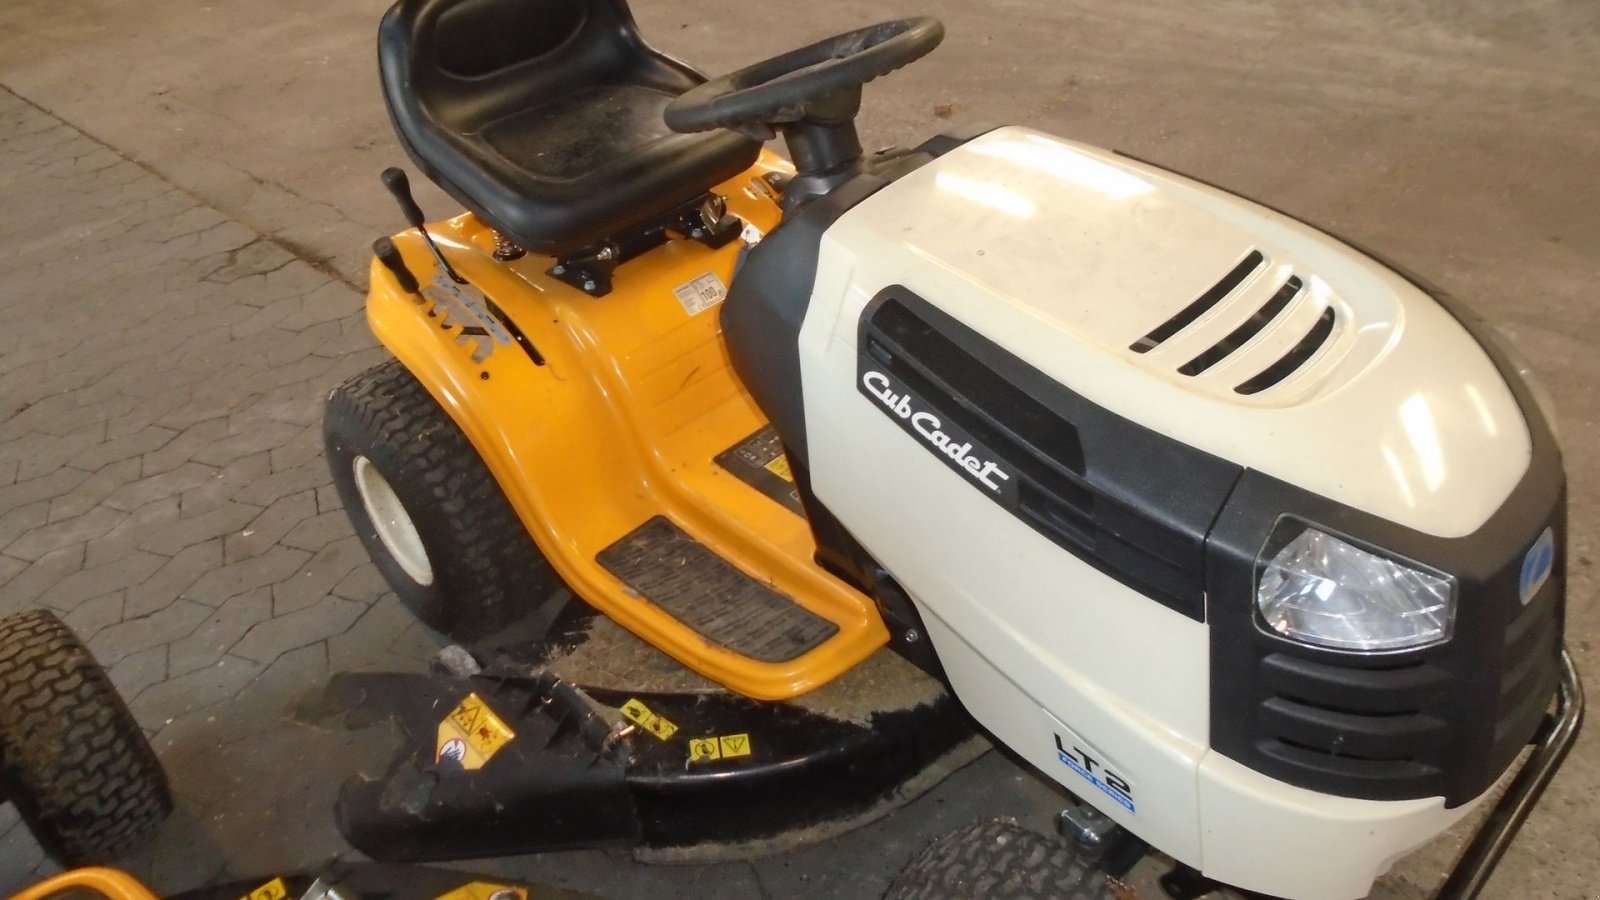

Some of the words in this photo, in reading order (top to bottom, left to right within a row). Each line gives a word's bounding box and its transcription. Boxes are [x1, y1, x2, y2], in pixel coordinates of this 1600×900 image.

[701, 286, 717, 301] 100
[863, 371, 912, 419] Cub
[911, 411, 1010, 491] Cadet
